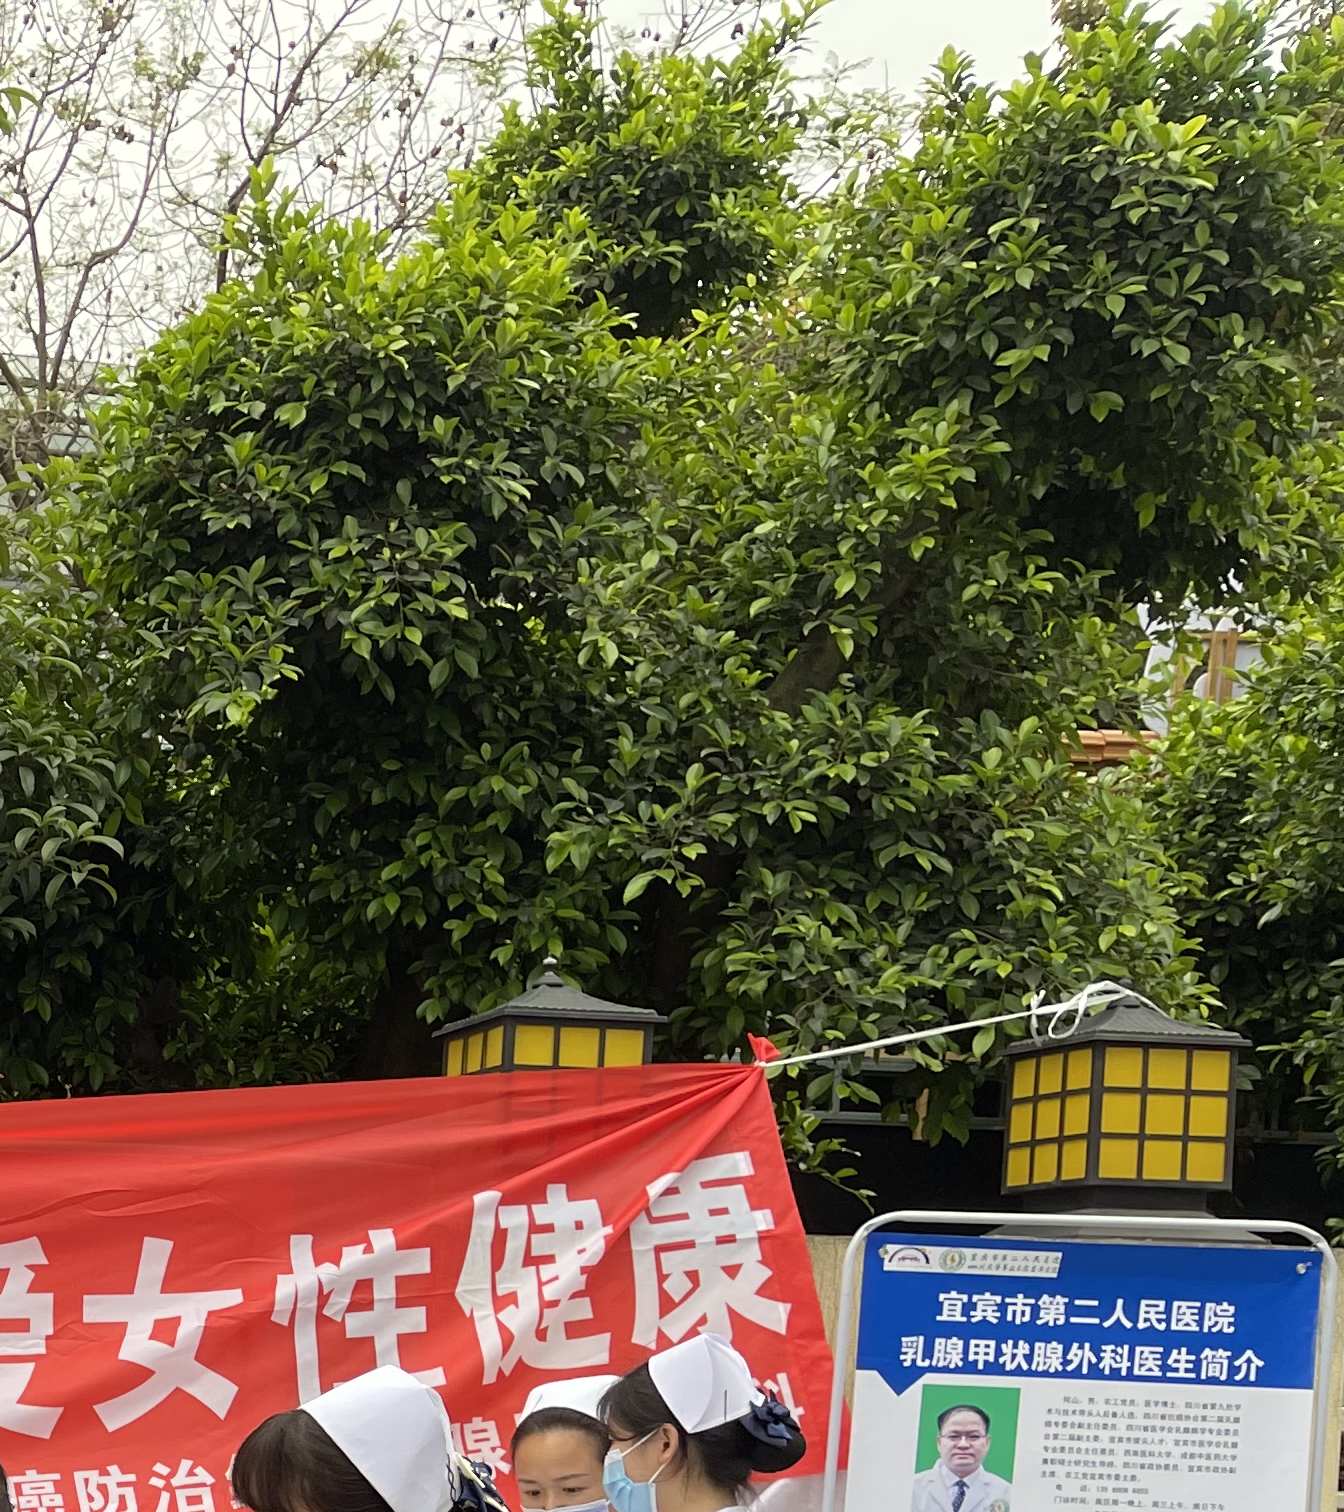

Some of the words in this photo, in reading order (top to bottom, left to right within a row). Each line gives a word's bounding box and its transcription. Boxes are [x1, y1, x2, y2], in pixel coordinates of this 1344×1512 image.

[935, 1290, 1236, 1335] 宜宾市第二人民医院
[898, 1335, 1266, 1382] 乳腺甲状腺外科医生简介
